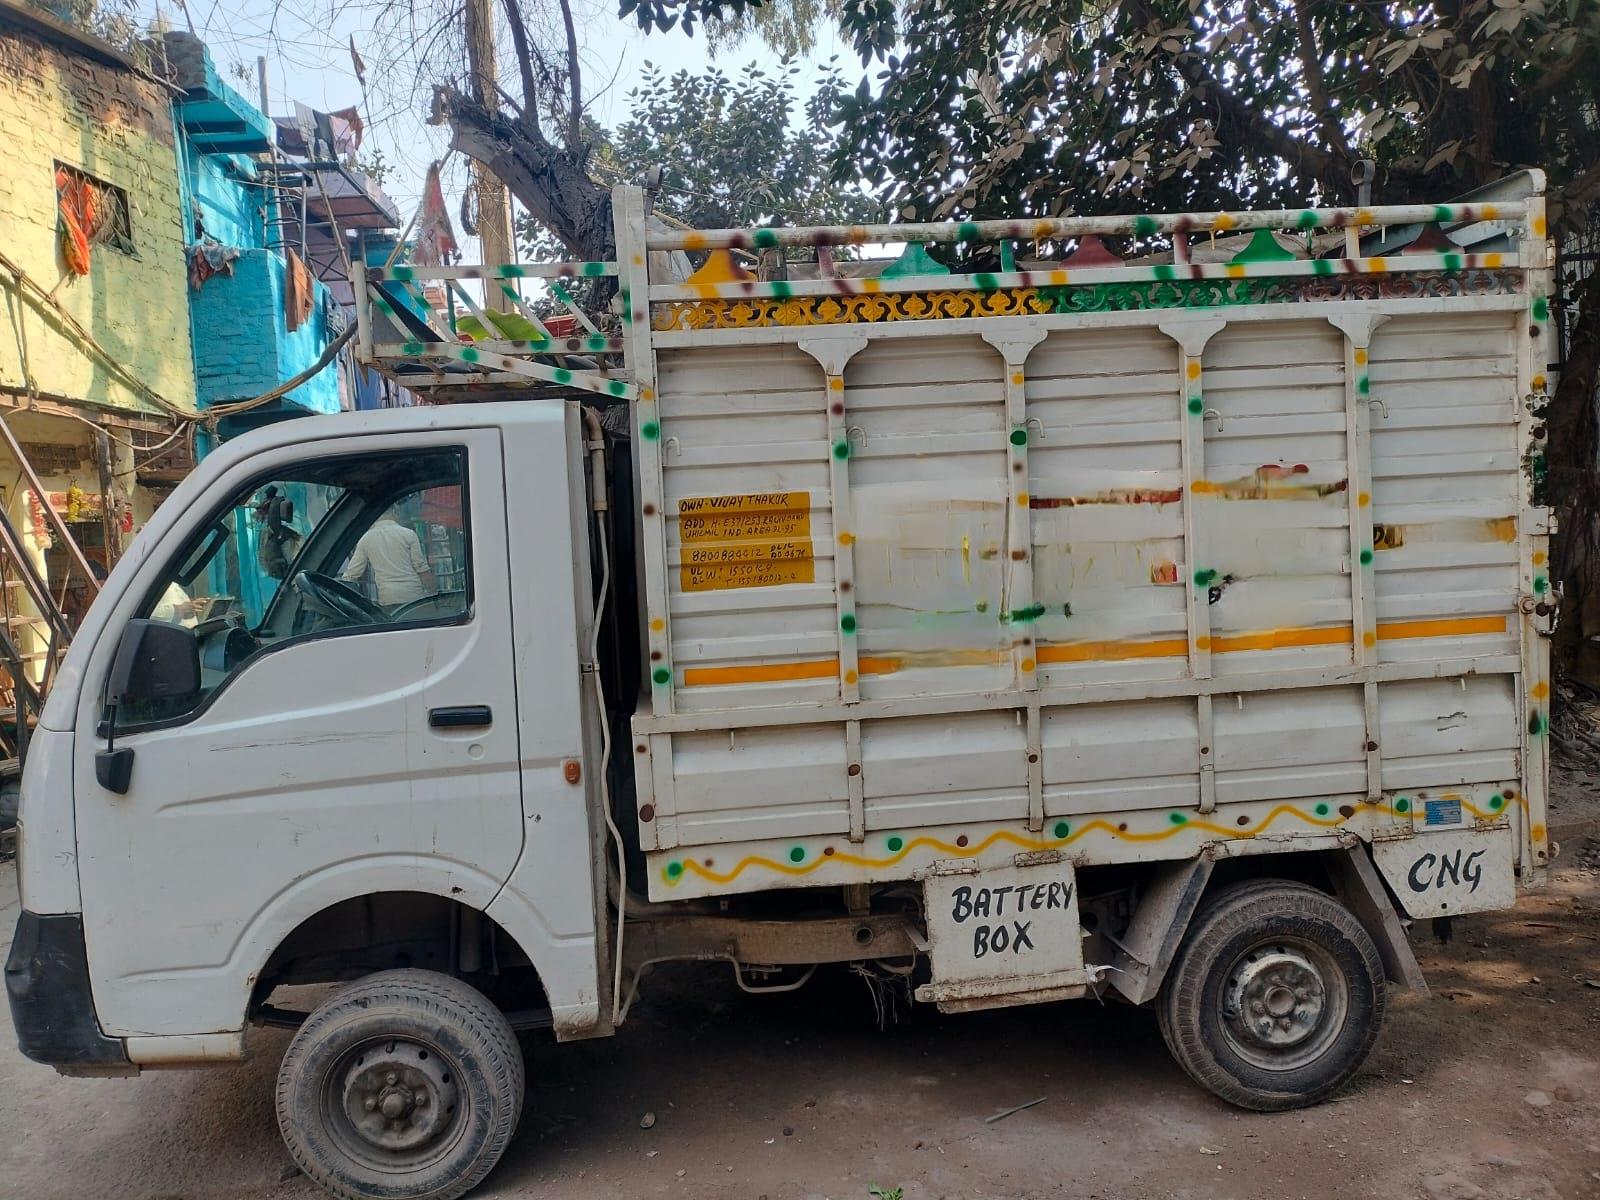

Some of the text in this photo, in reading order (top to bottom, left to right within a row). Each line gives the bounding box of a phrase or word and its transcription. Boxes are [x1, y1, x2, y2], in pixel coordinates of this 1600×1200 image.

[747, 493, 789, 506] THAKUR
[1407, 848, 1488, 894] CNG
[950, 881, 1074, 923] BATTERY
[973, 920, 1035, 959] BOX
